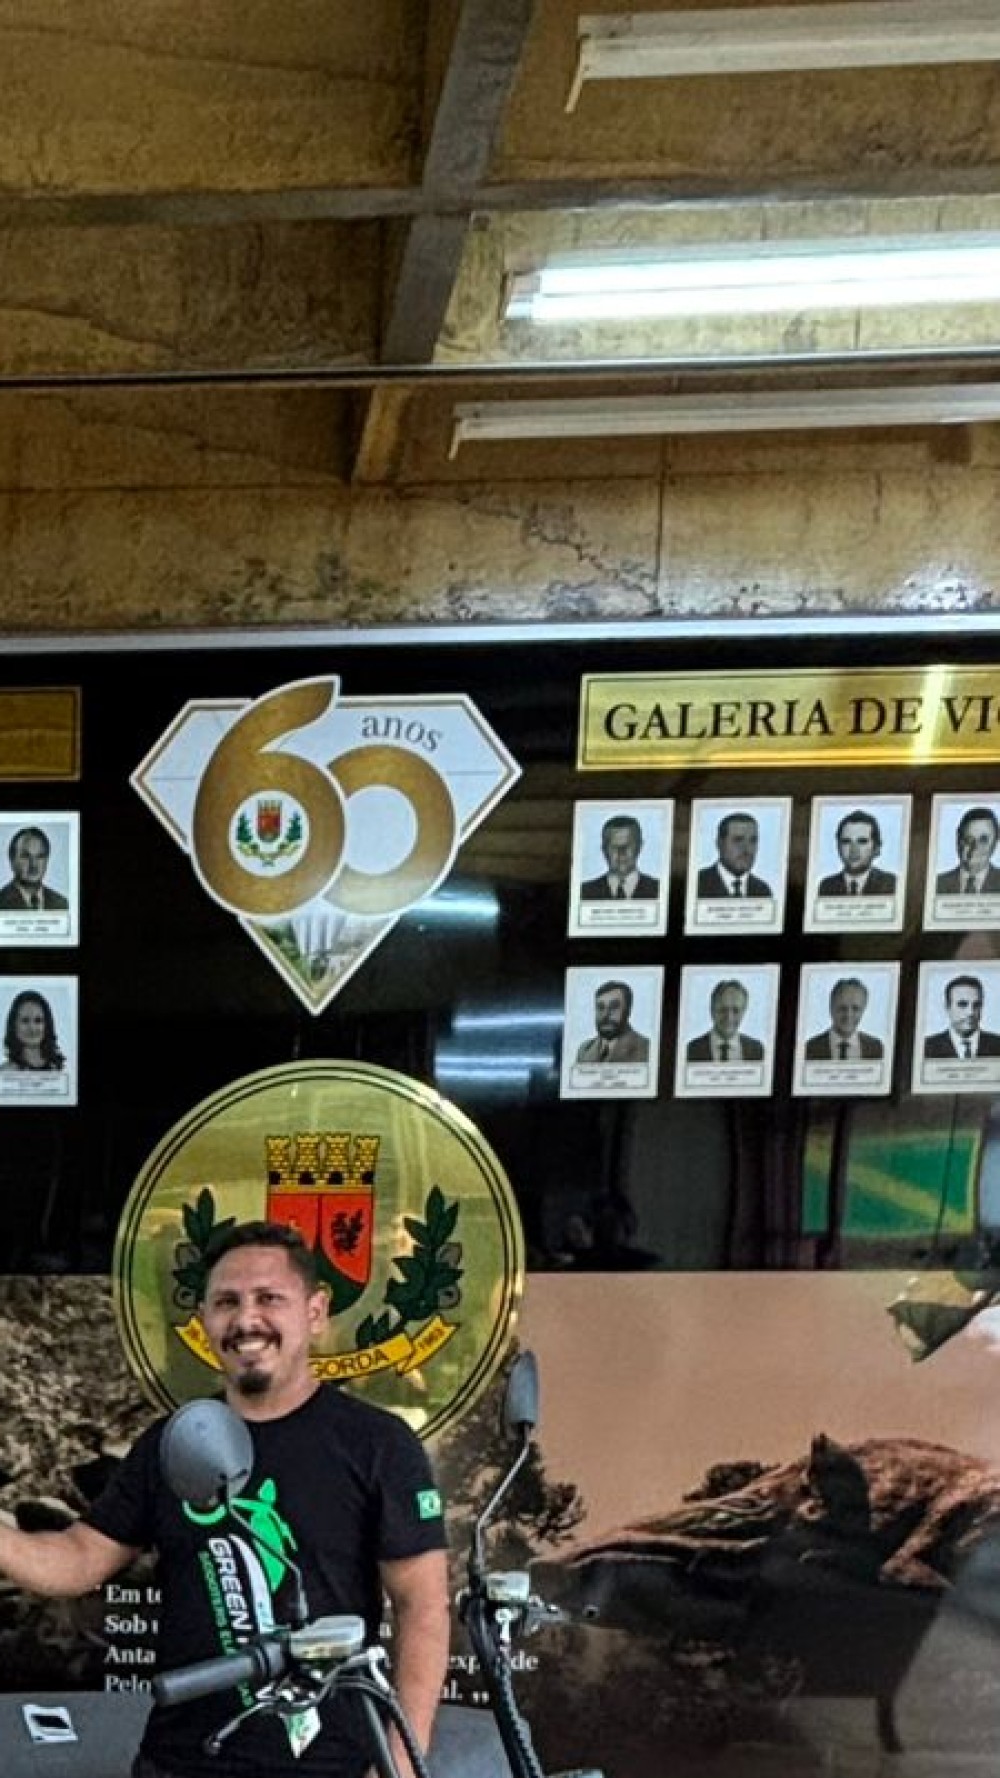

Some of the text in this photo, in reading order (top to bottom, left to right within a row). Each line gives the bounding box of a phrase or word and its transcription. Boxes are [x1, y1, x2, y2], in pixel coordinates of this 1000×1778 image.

[361, 714, 443, 753] anos
[603, 695, 1000, 740] GALERIA DE VI
[193, 678, 458, 916] 60
[105, 1584, 141, 1604] Em
[208, 1537, 253, 1630] GREEN
[104, 1614, 148, 1634] Sob
